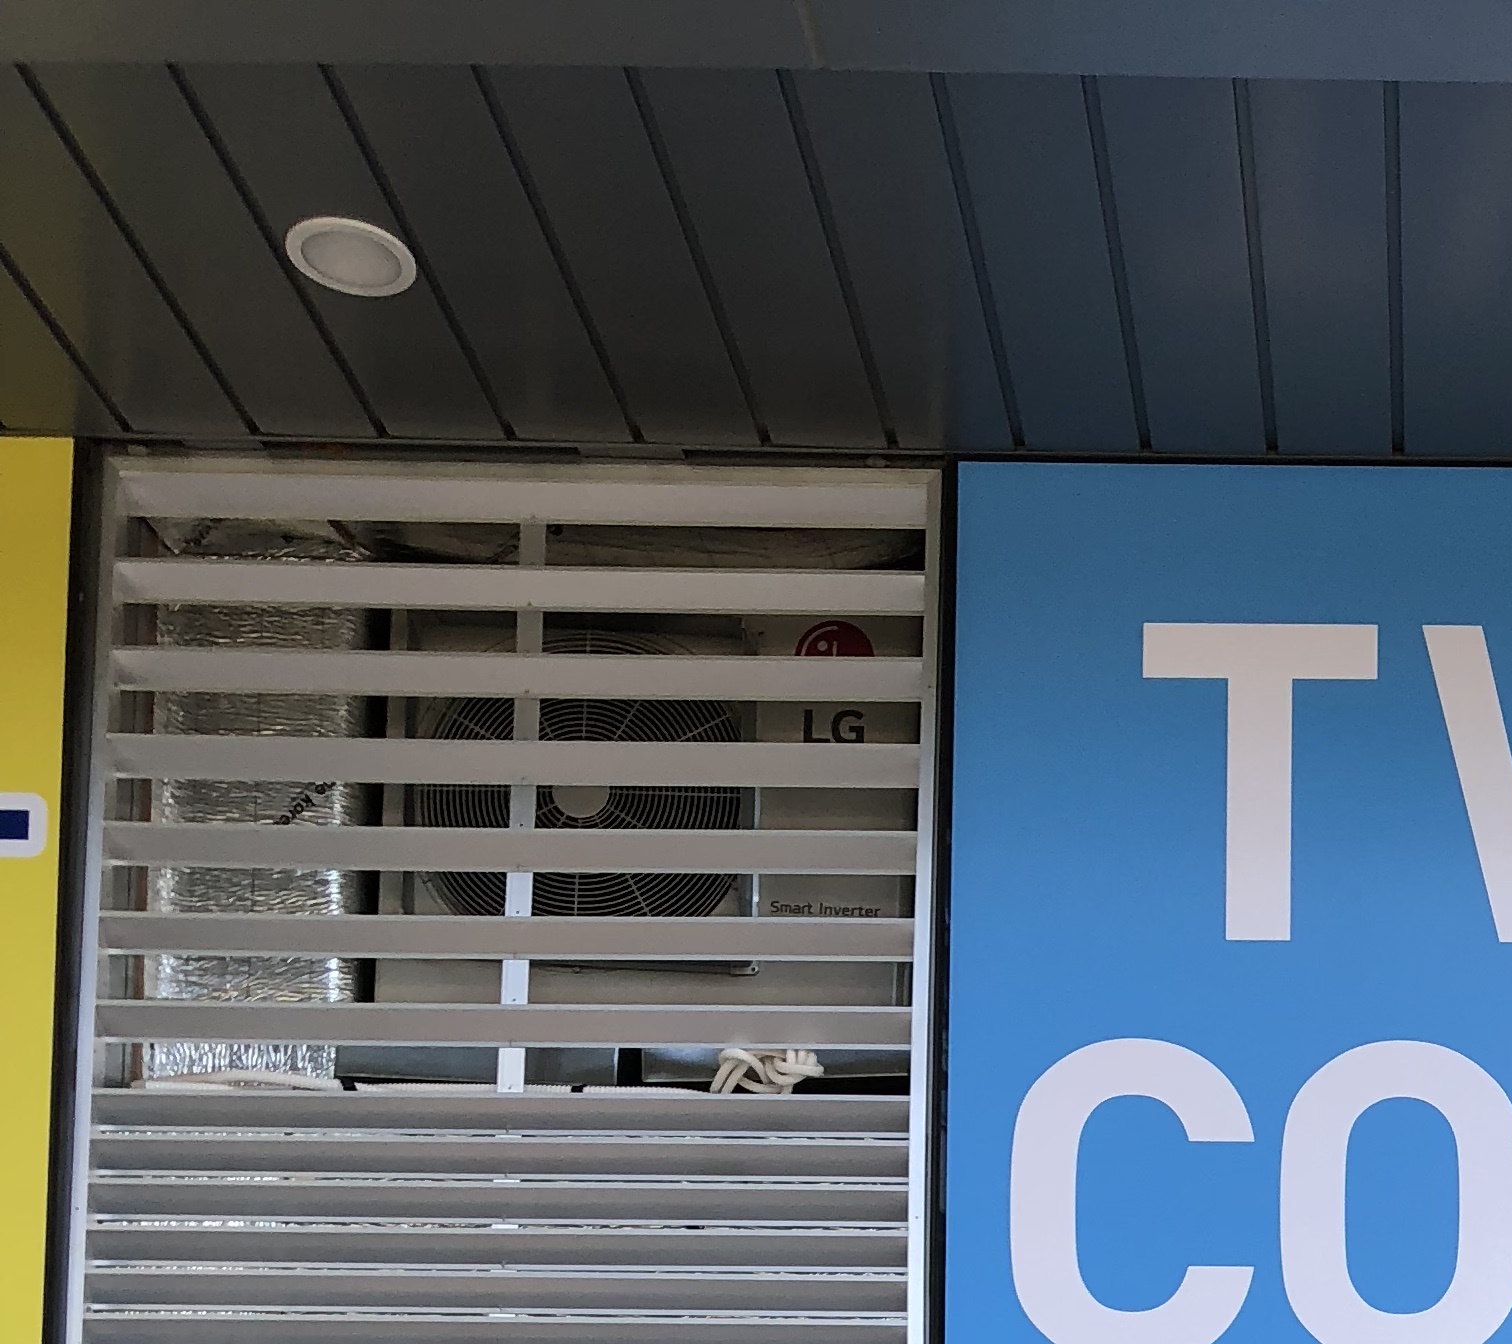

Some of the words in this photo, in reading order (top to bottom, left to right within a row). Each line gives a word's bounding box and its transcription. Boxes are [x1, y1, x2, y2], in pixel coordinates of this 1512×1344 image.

[802, 708, 866, 744] LG
[770, 900, 814, 916] Smart
[819, 902, 881, 918] Inverter
